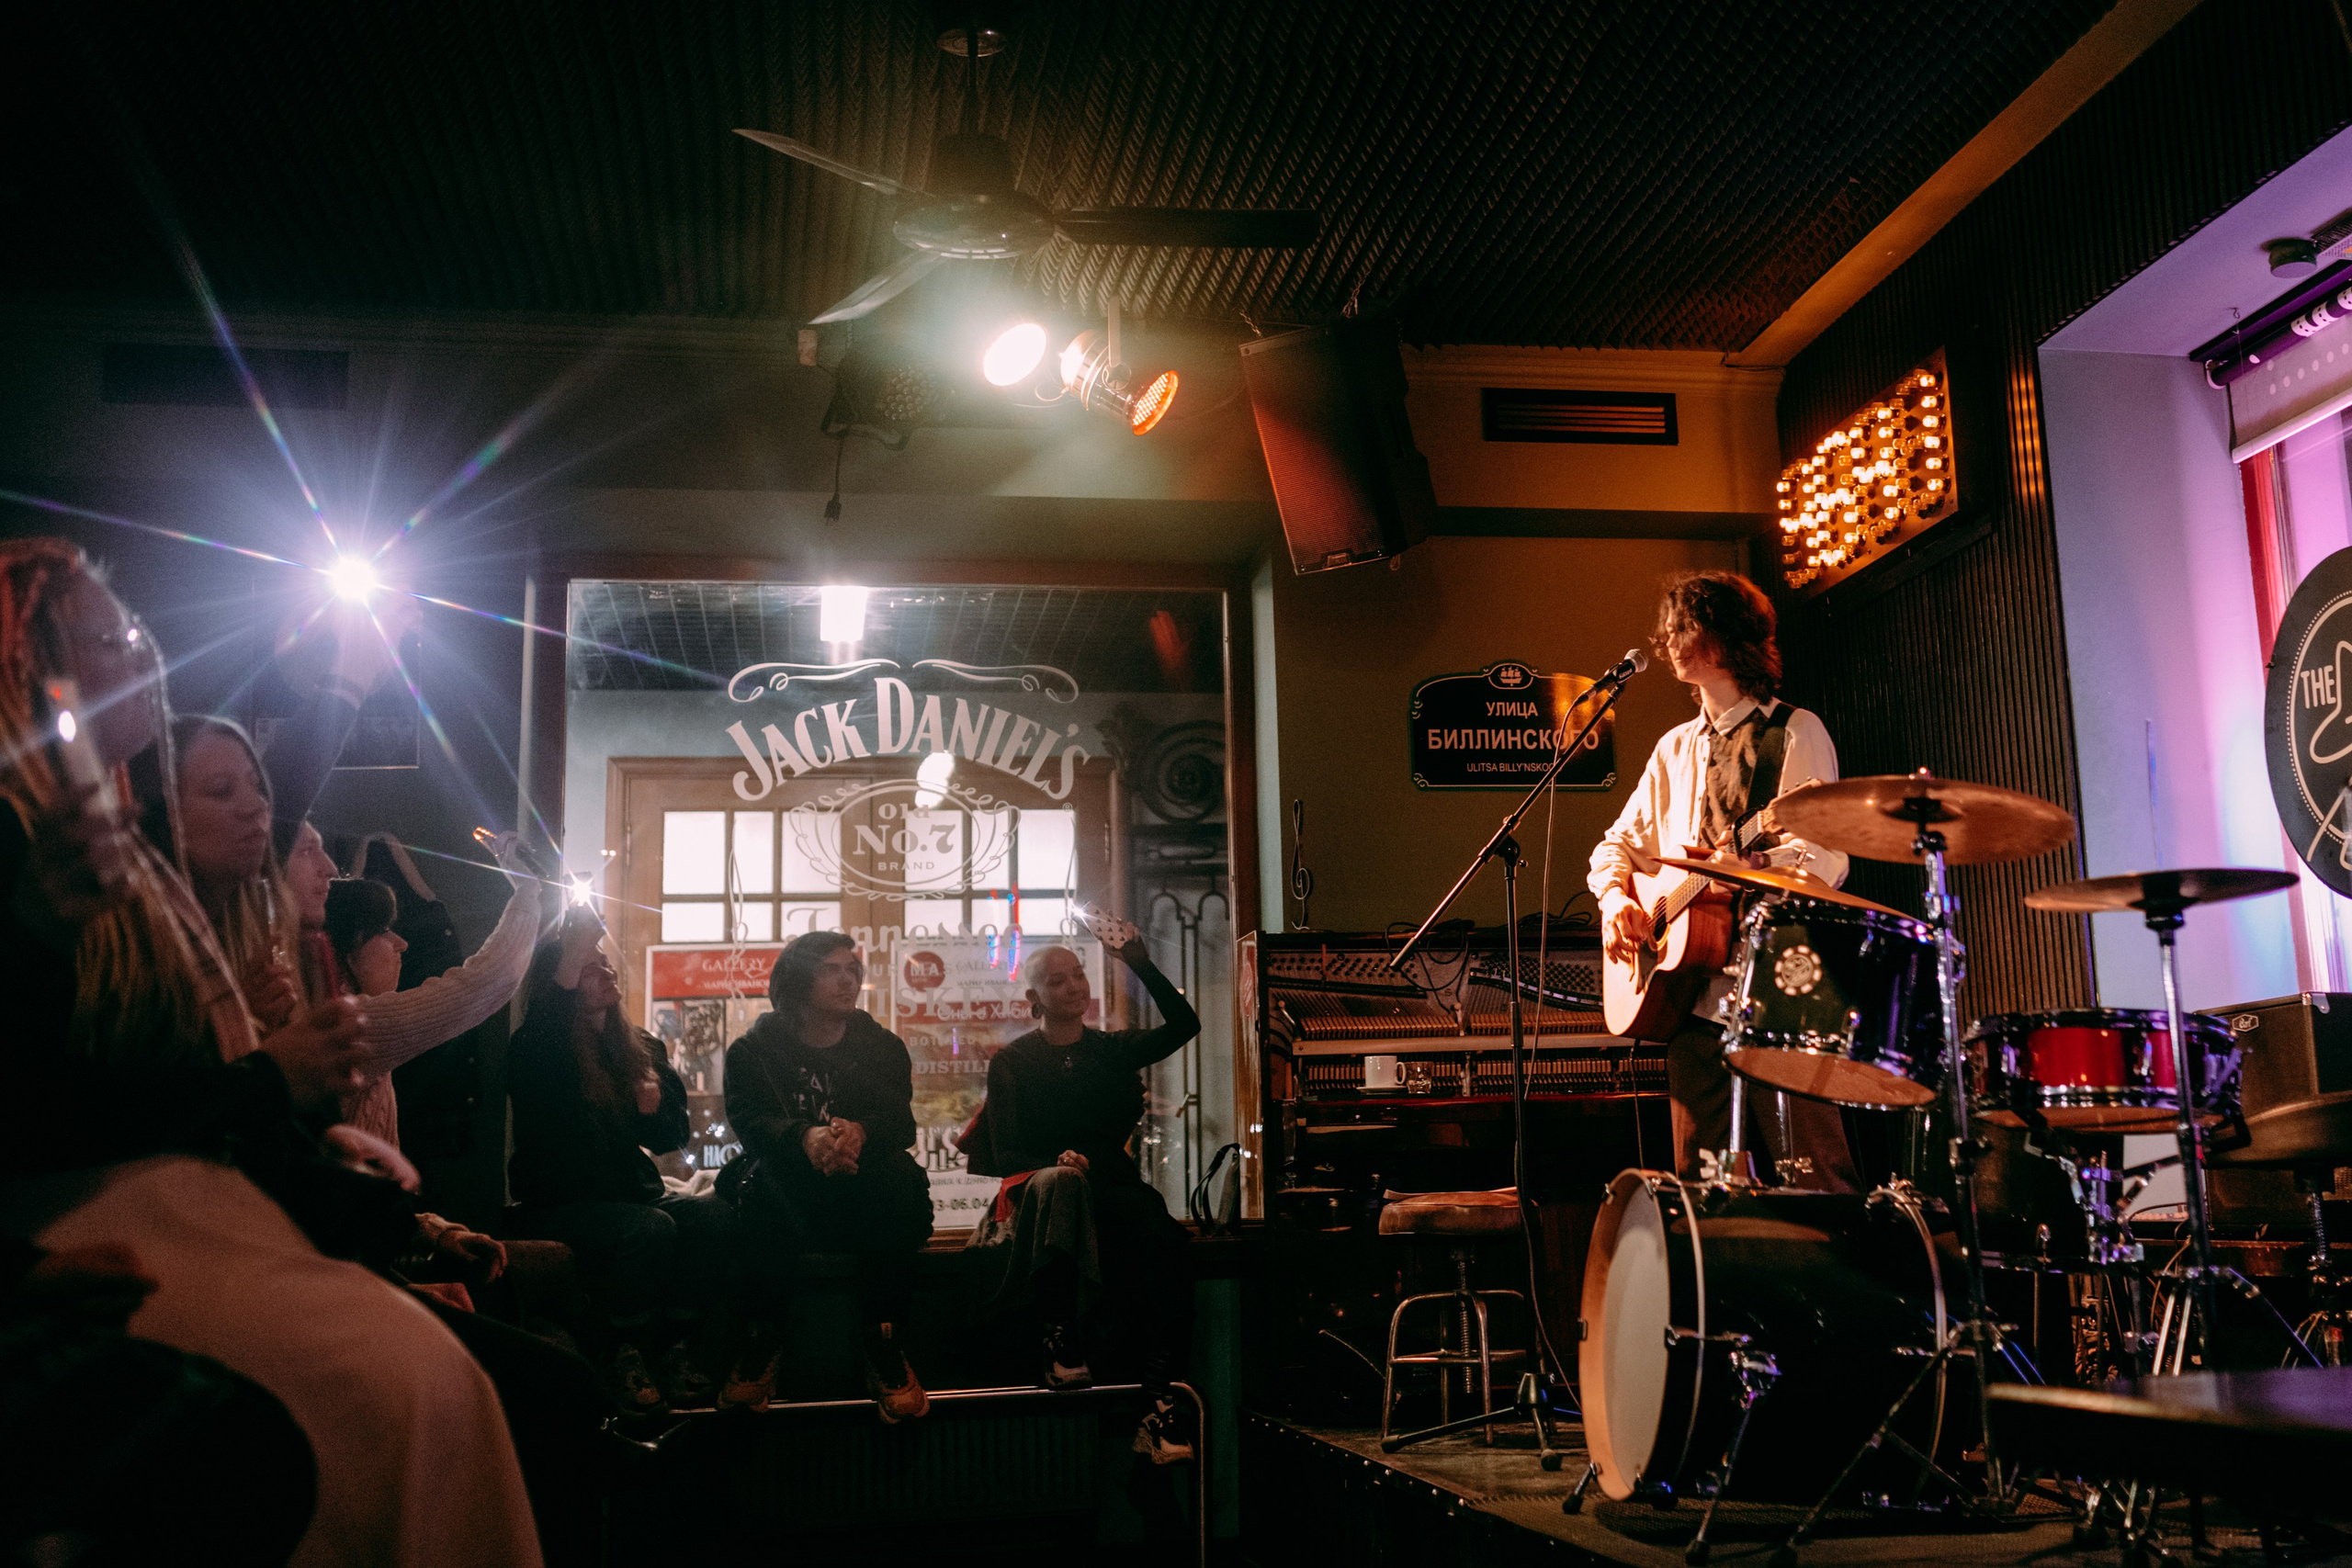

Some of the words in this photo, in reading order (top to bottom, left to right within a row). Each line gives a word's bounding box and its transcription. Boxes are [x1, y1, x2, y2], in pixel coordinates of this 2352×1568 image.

[2300, 664, 2335, 709] THE
[1486, 701, 1539, 719] УЛИЦА
[725, 698, 872, 801] JACK
[875, 677, 1091, 801] DANIEL'S
[1427, 728, 1600, 750] БИЛЛИНСКОГО
[1466, 762, 1498, 773] ULITSA
[1498, 762, 1560, 773] BILLY'NSKOG
[853, 823, 956, 856] No.7
[877, 861, 935, 872] BRAND
